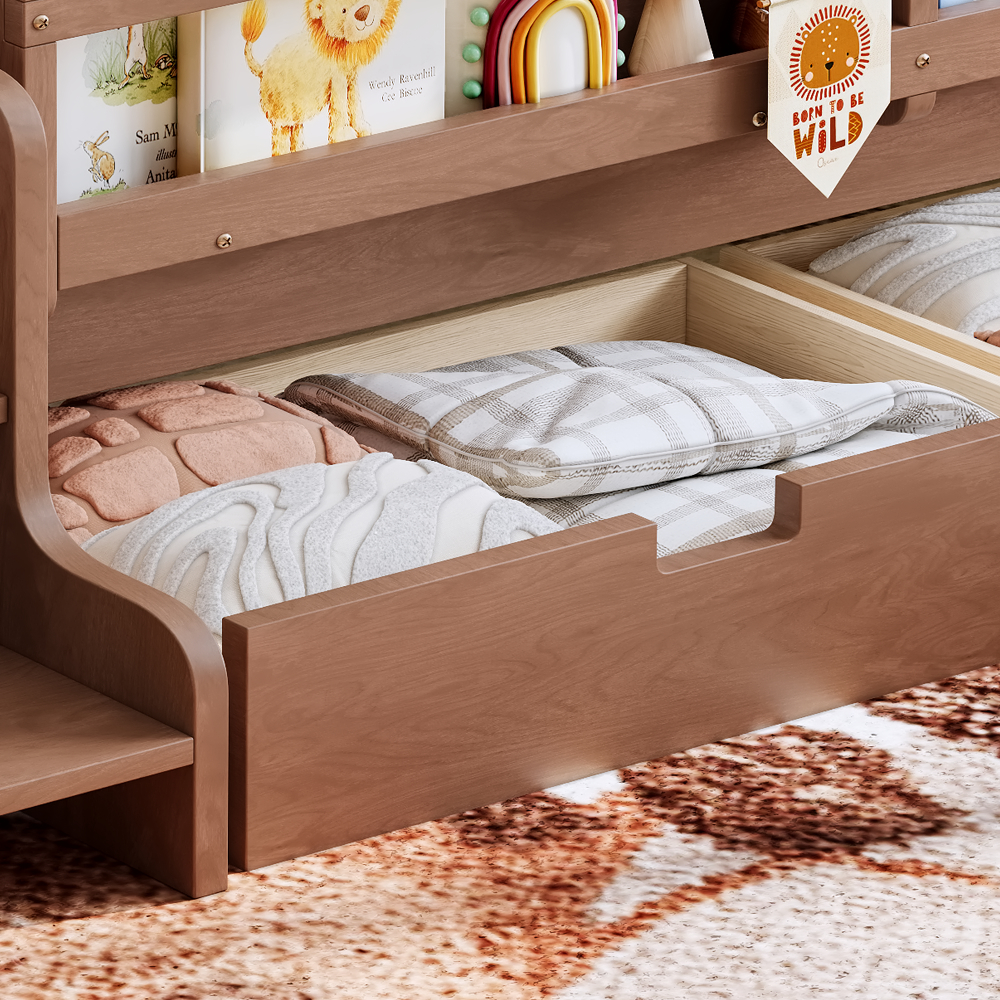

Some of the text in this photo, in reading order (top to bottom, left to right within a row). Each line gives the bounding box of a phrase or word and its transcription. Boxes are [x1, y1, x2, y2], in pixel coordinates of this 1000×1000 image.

[368, 66, 436, 90] Wendy Ravenhill
[792, 91, 864, 126] BORN TO BE
[135, 129, 160, 145] Sam
[145, 167, 177, 184] Anita
